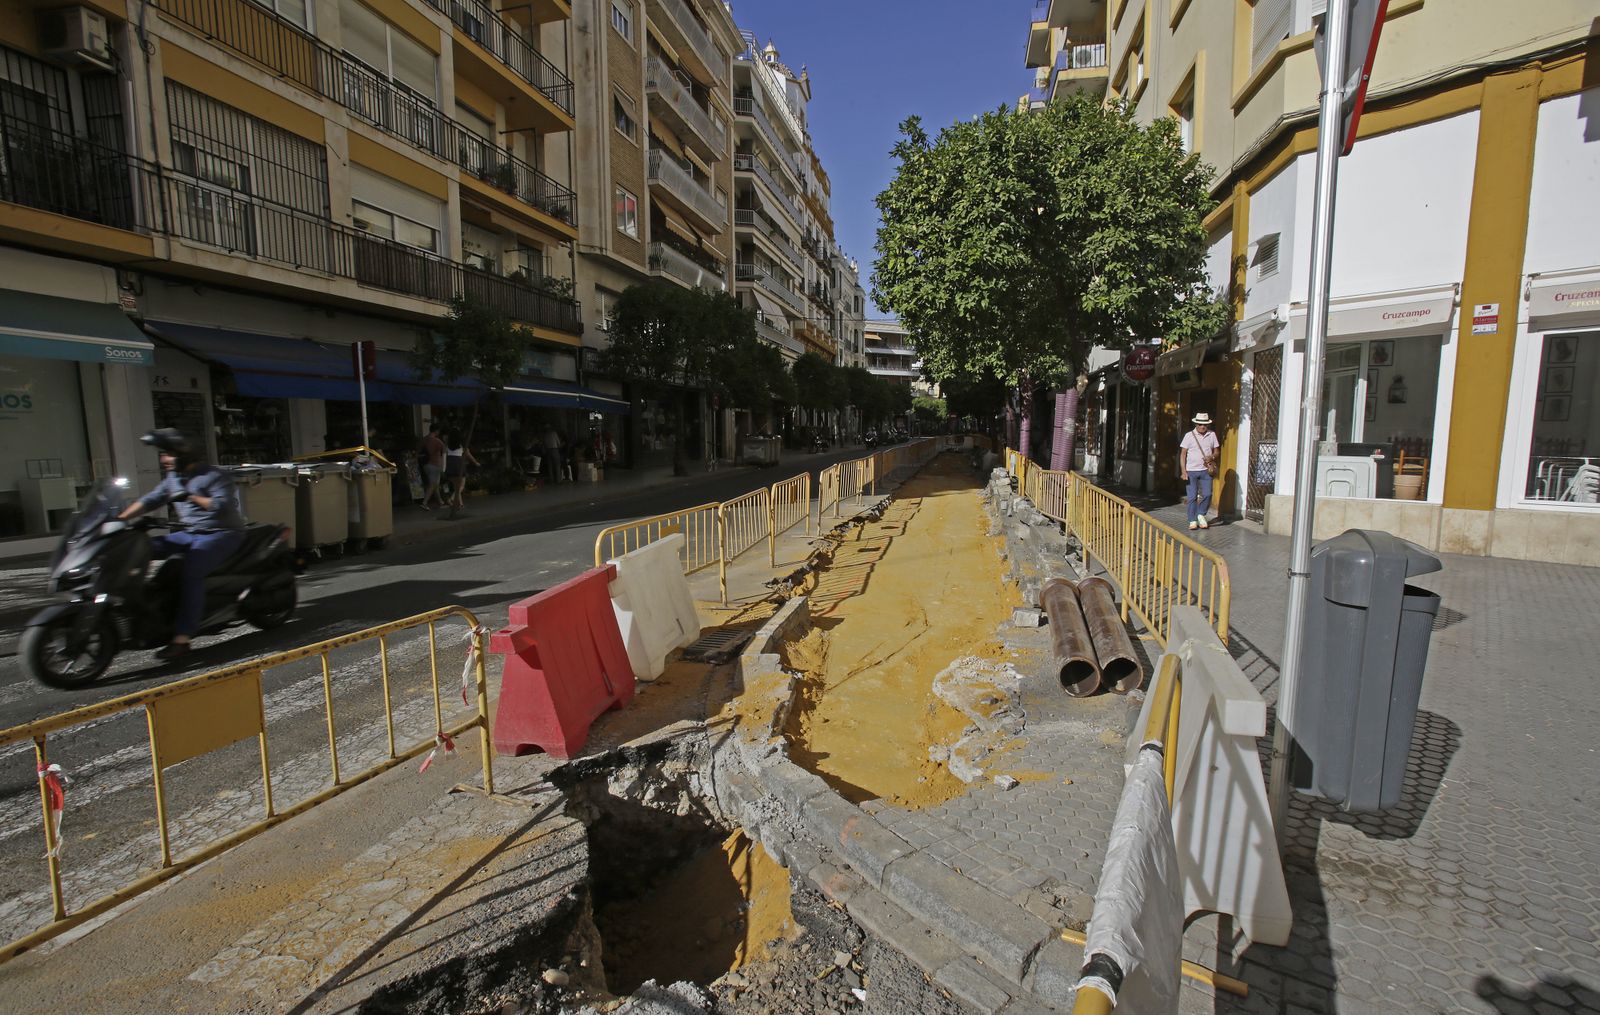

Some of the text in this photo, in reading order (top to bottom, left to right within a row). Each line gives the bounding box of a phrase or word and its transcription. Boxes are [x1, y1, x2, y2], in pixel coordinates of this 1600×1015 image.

[1382, 308, 1431, 320] Cruzcampo
[104, 346, 142, 358] Sonos
[0, 394, 32, 408] os
